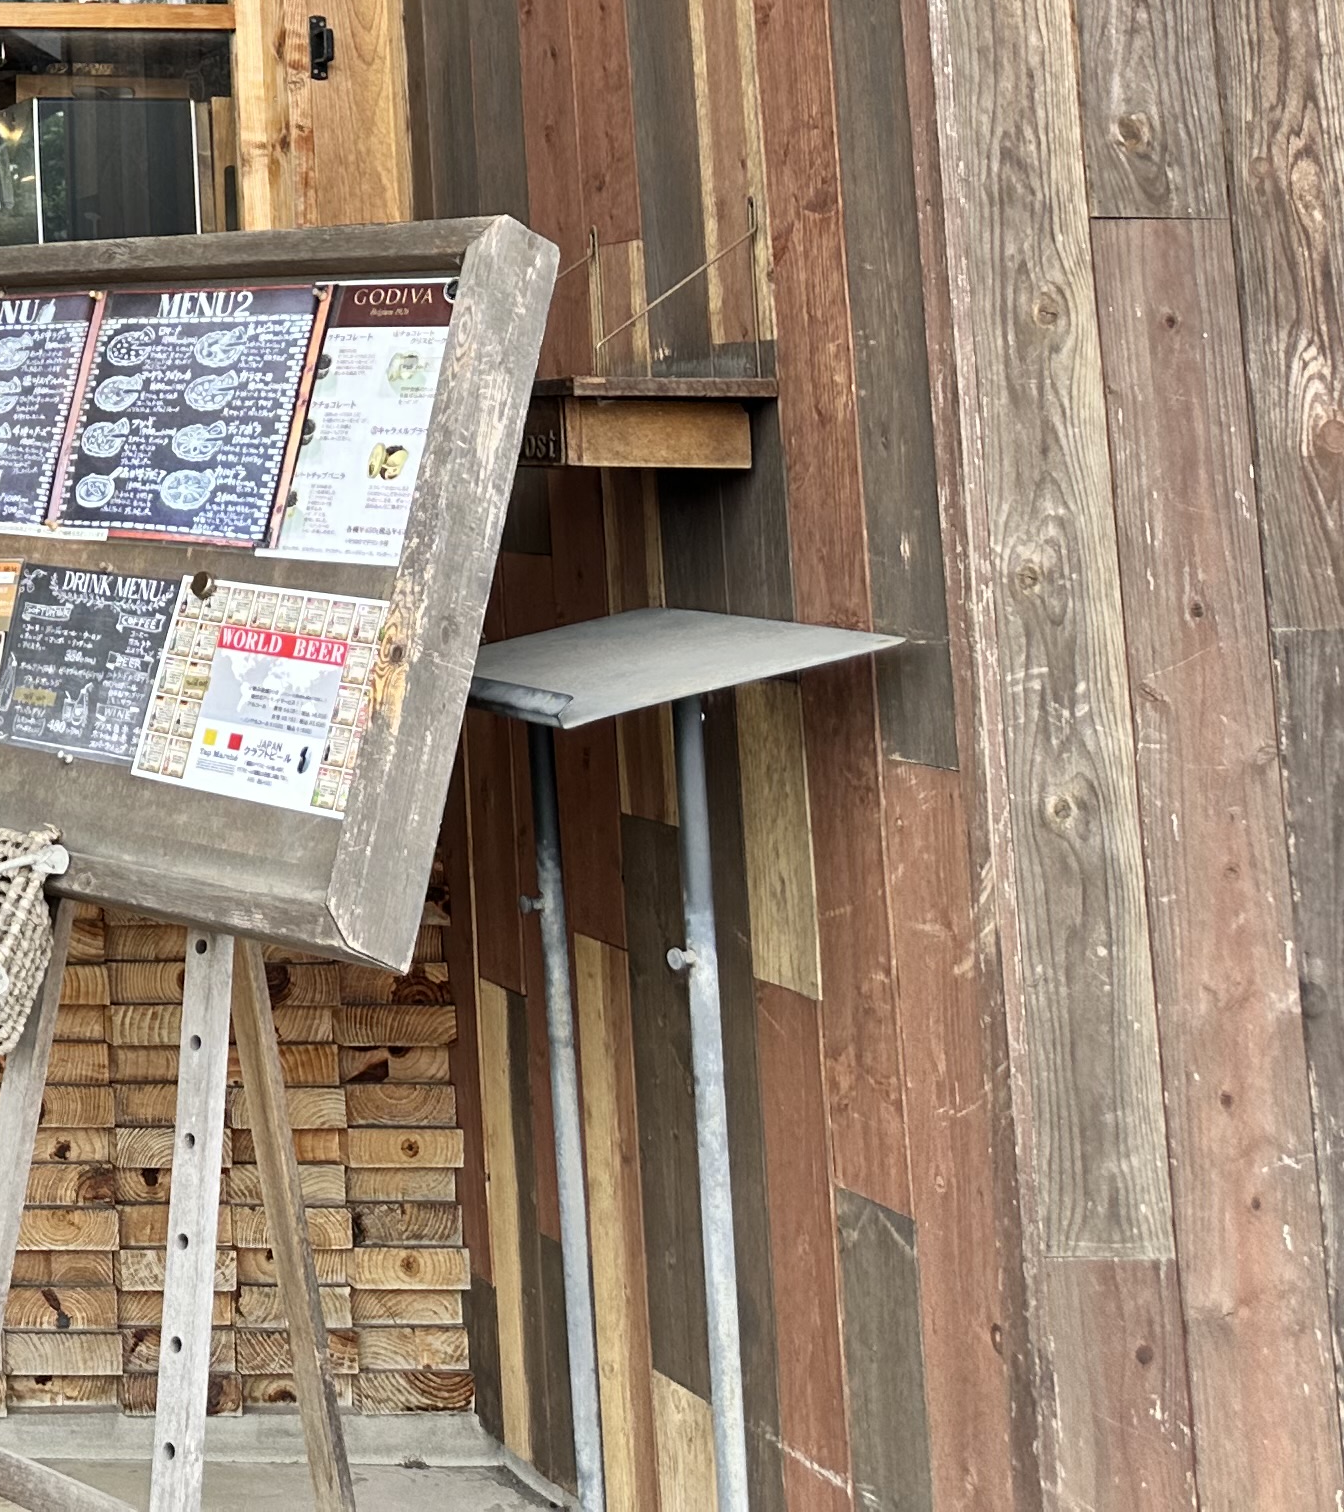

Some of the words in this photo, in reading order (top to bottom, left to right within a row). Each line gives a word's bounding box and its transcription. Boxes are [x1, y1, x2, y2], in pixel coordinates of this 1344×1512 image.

[354, 287, 433, 306] GODIVA
[524, 428, 557, 459] ost
[63, 570, 112, 596] DRINK
[113, 576, 165, 601] MENU
[121, 616, 157, 630] COFFEE
[220, 626, 283, 655] WORLD
[292, 639, 345, 664] BEER
[104, 707, 132, 721] WINE
[257, 738, 284, 752] JAPAN
